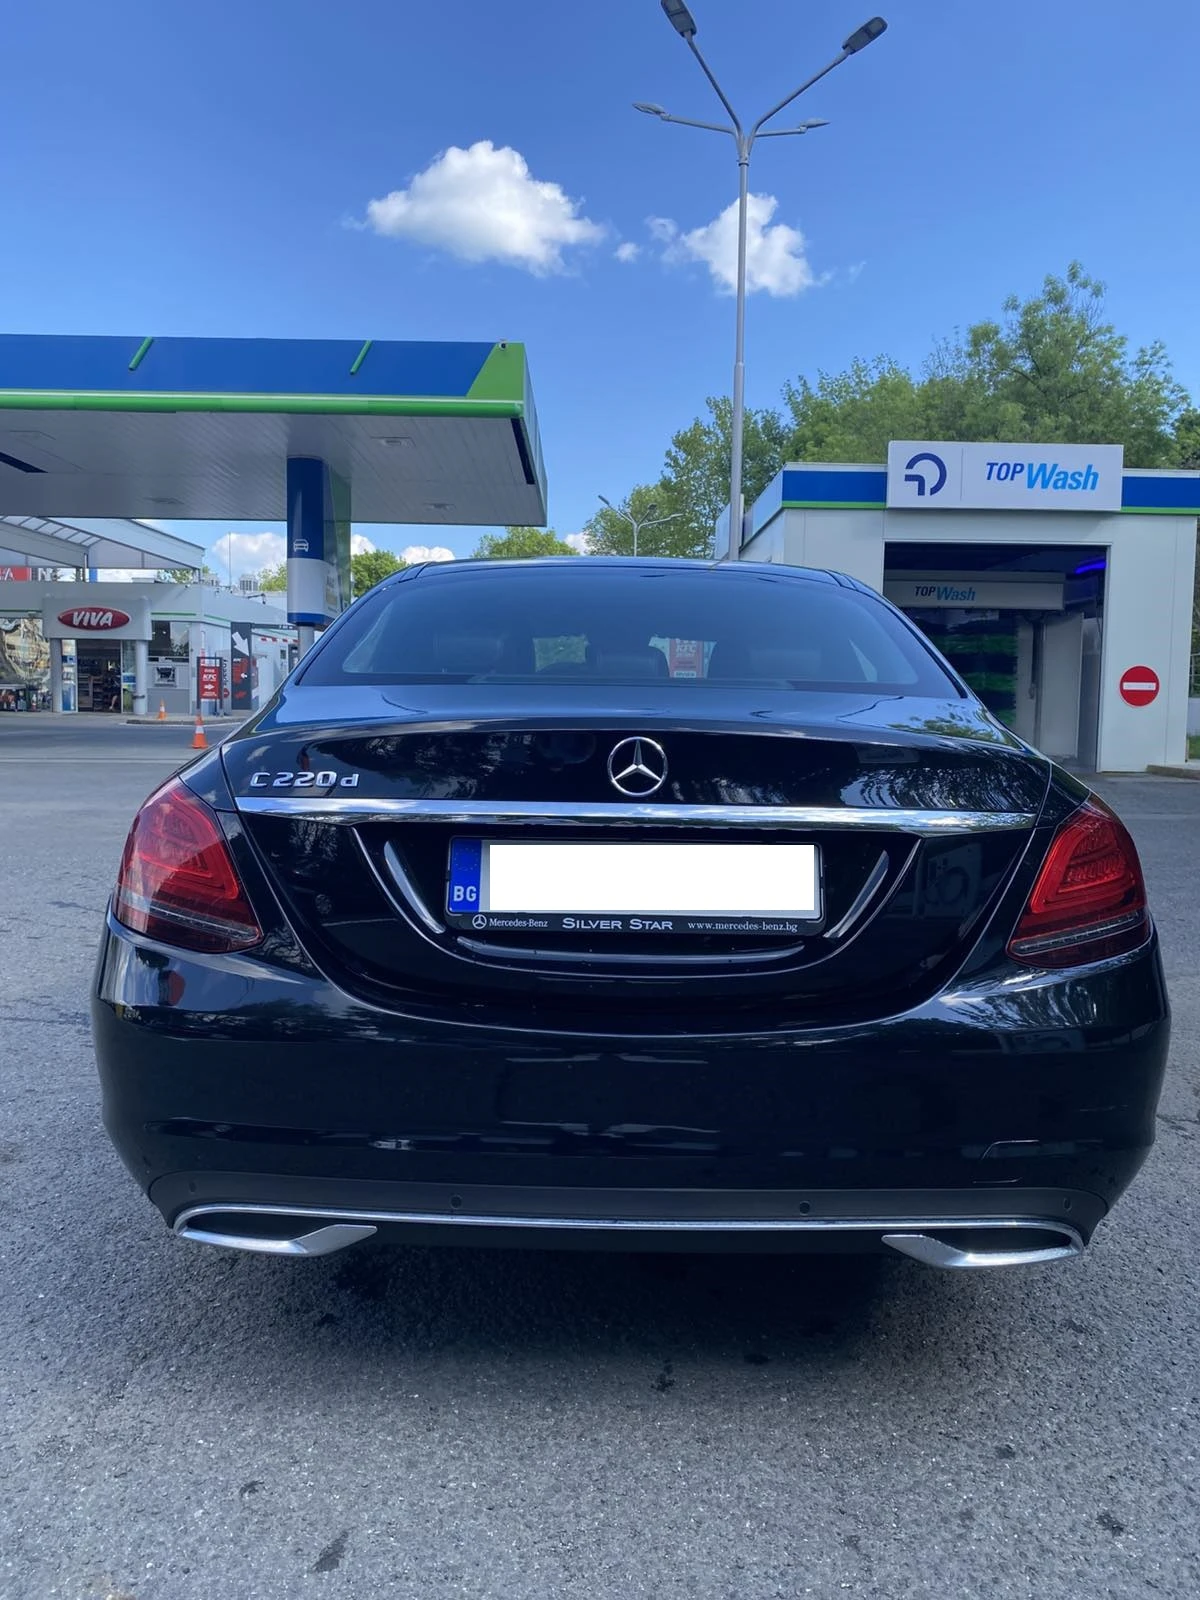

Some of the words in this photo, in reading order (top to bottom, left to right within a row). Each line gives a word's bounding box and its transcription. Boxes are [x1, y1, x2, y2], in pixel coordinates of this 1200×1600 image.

[72, 611, 113, 627] VIVA
[453, 885, 477, 902] BG
[489, 917, 549, 928] Mercedes-Benz
[688, 921, 798, 932] www.mercedes-benz.bg
